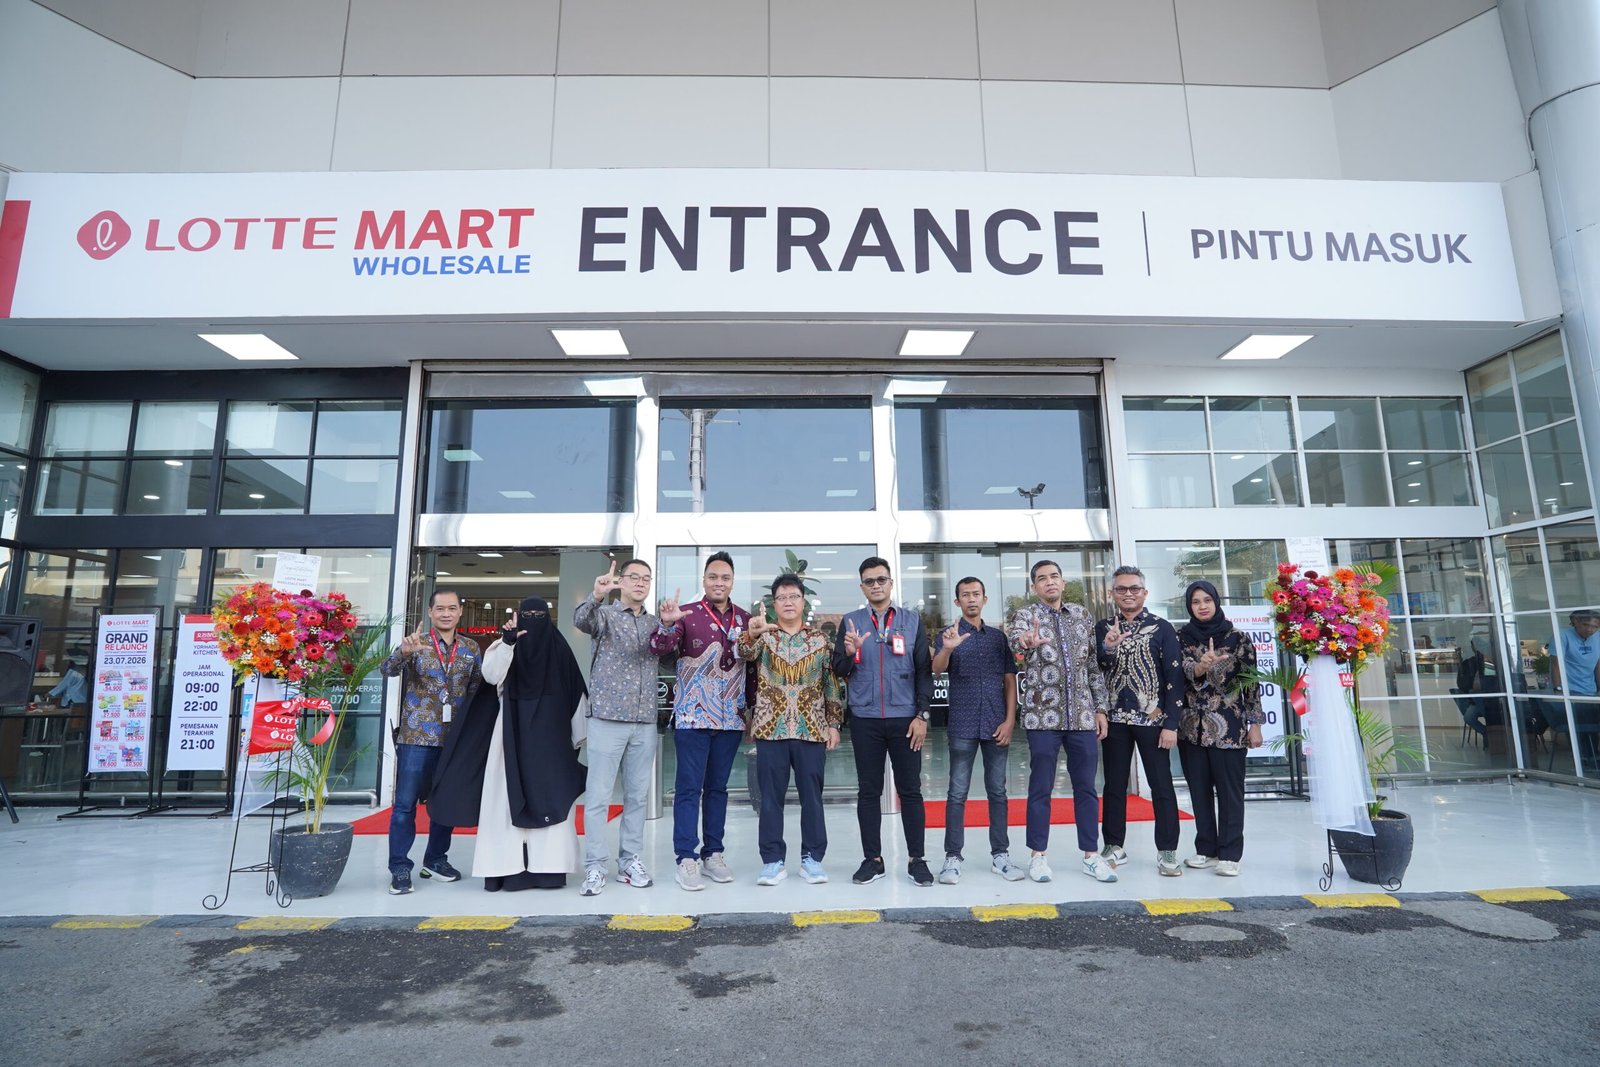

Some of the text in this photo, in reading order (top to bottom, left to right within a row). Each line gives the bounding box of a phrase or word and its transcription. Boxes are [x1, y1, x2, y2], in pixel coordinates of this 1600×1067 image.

[146, 207, 535, 251] LOTTE MART
[578, 206, 1104, 276] ENTRANCE
[1190, 228, 1473, 264] PINTU MASUK
[352, 254, 531, 277] WHOLESALE
[105, 632, 148, 644] GRAND
[104, 642, 148, 651] RE LAUNCH
[103, 656, 147, 665] 23.07.2026
[185, 682, 220, 693] 09:00
[183, 701, 218, 712] 22:00
[180, 739, 215, 750] 21:00
